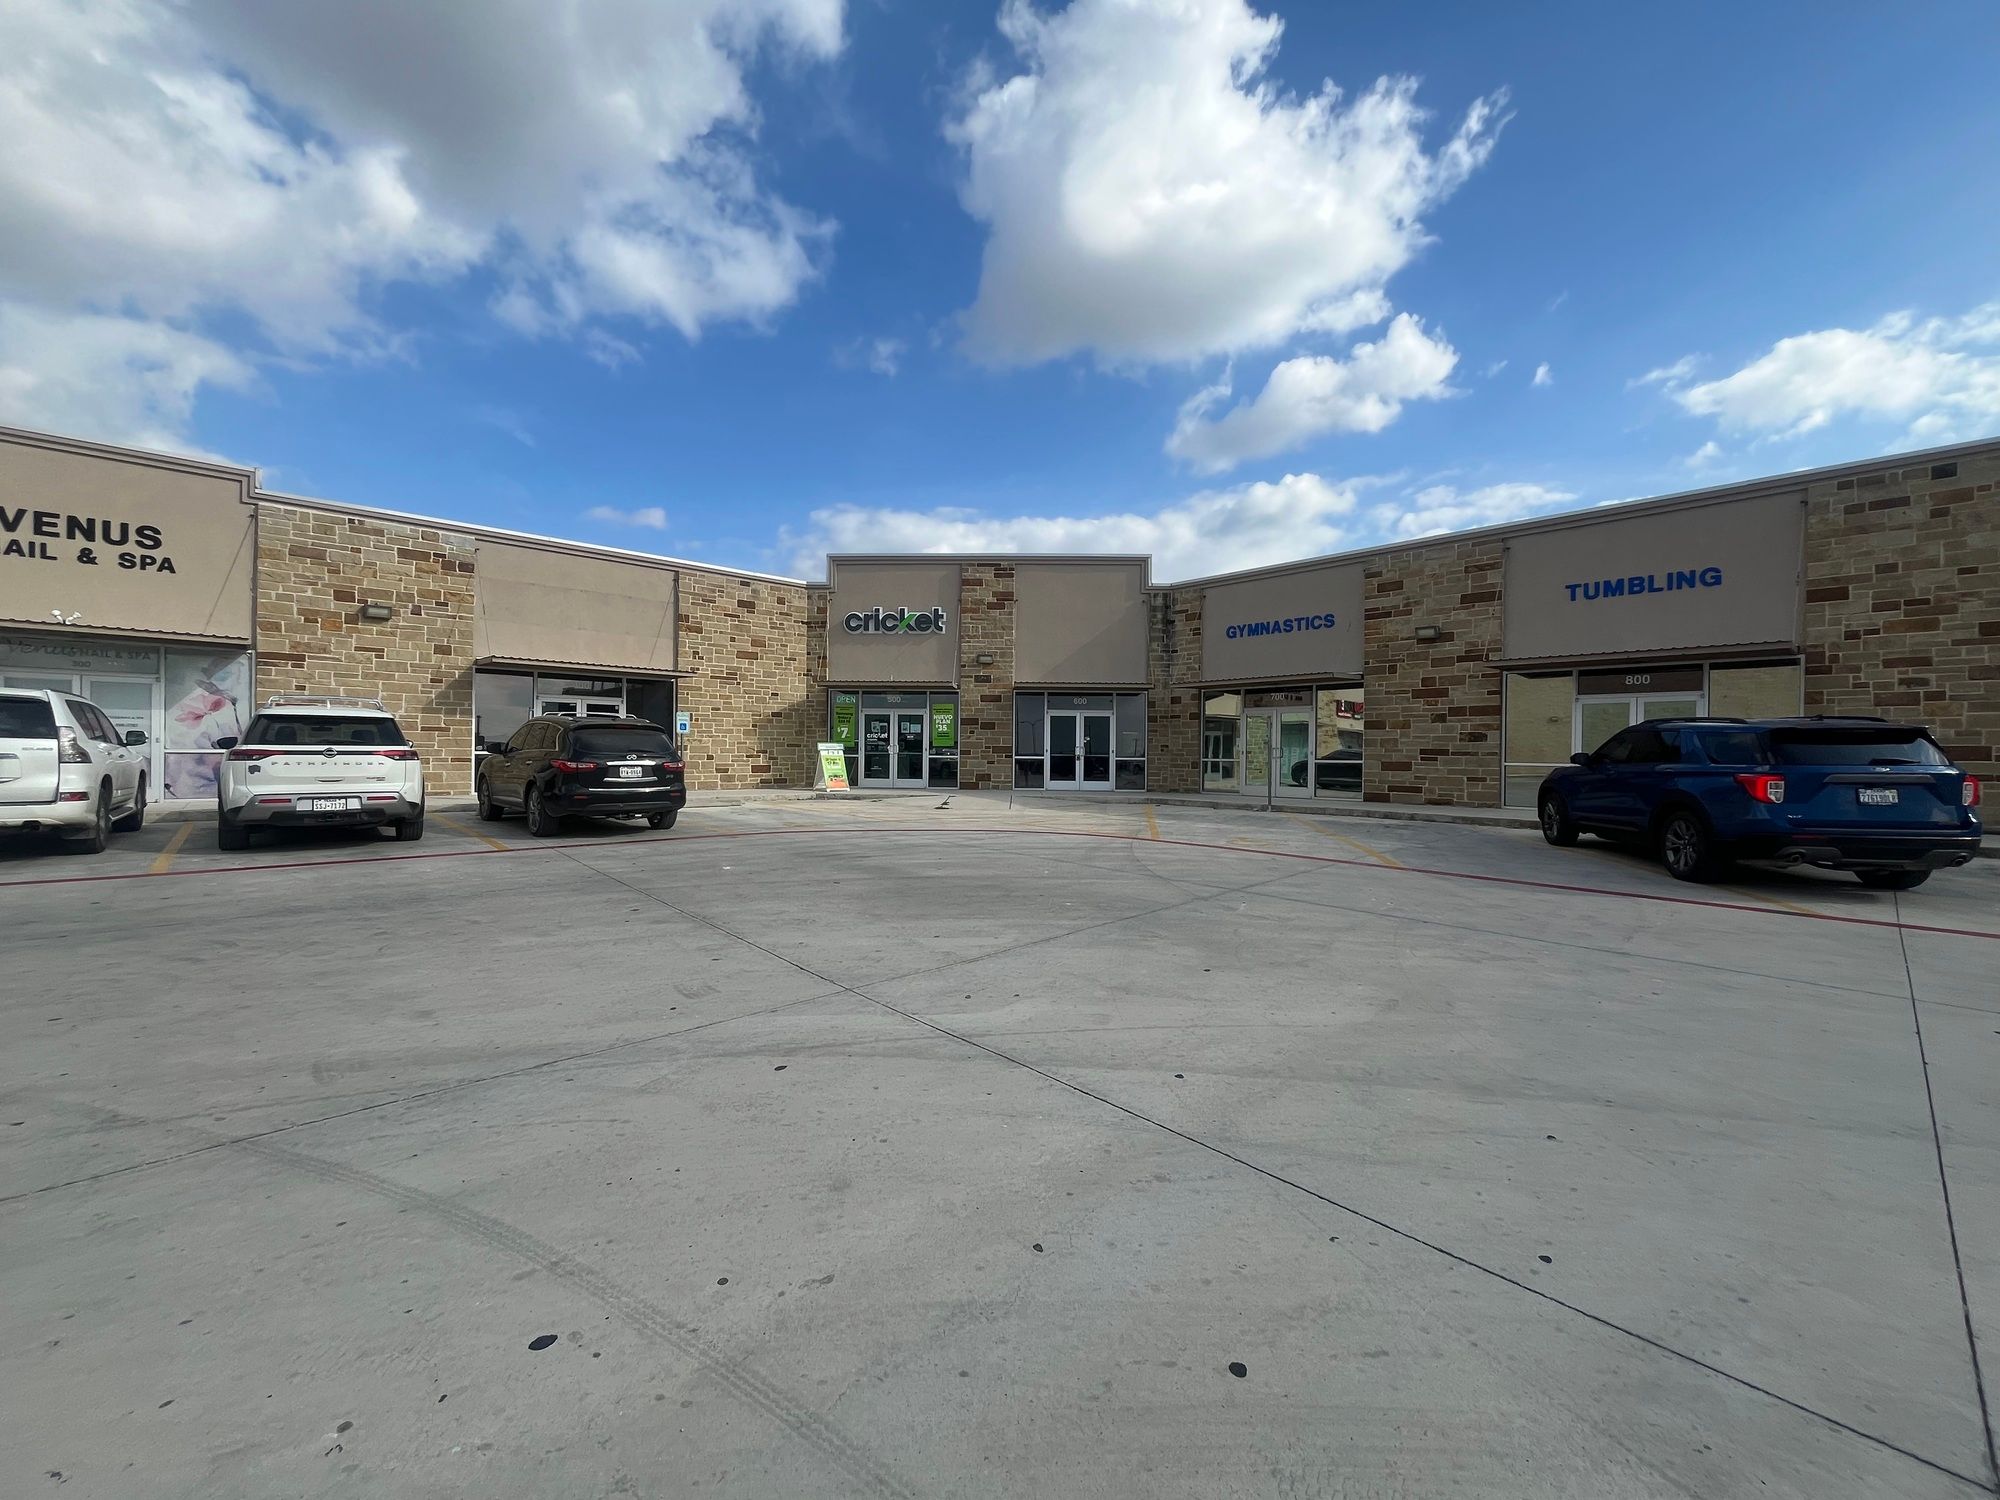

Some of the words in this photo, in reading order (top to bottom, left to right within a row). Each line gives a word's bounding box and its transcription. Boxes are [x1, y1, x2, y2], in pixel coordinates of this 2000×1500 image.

[0, 505, 162, 550] VENUS
[2, 539, 58, 561] AIL
[77, 547, 99, 566] &
[118, 552, 176, 574] SPA
[1565, 567, 1722, 601] TUMBLING
[843, 606, 946, 634] cricket
[1226, 613, 1336, 639] GYMNASTICS
[127, 651, 151, 660] SPA
[1625, 674, 1650, 685] 800
[836, 695, 856, 703] OPEN
[1073, 697, 1087, 705] 600
